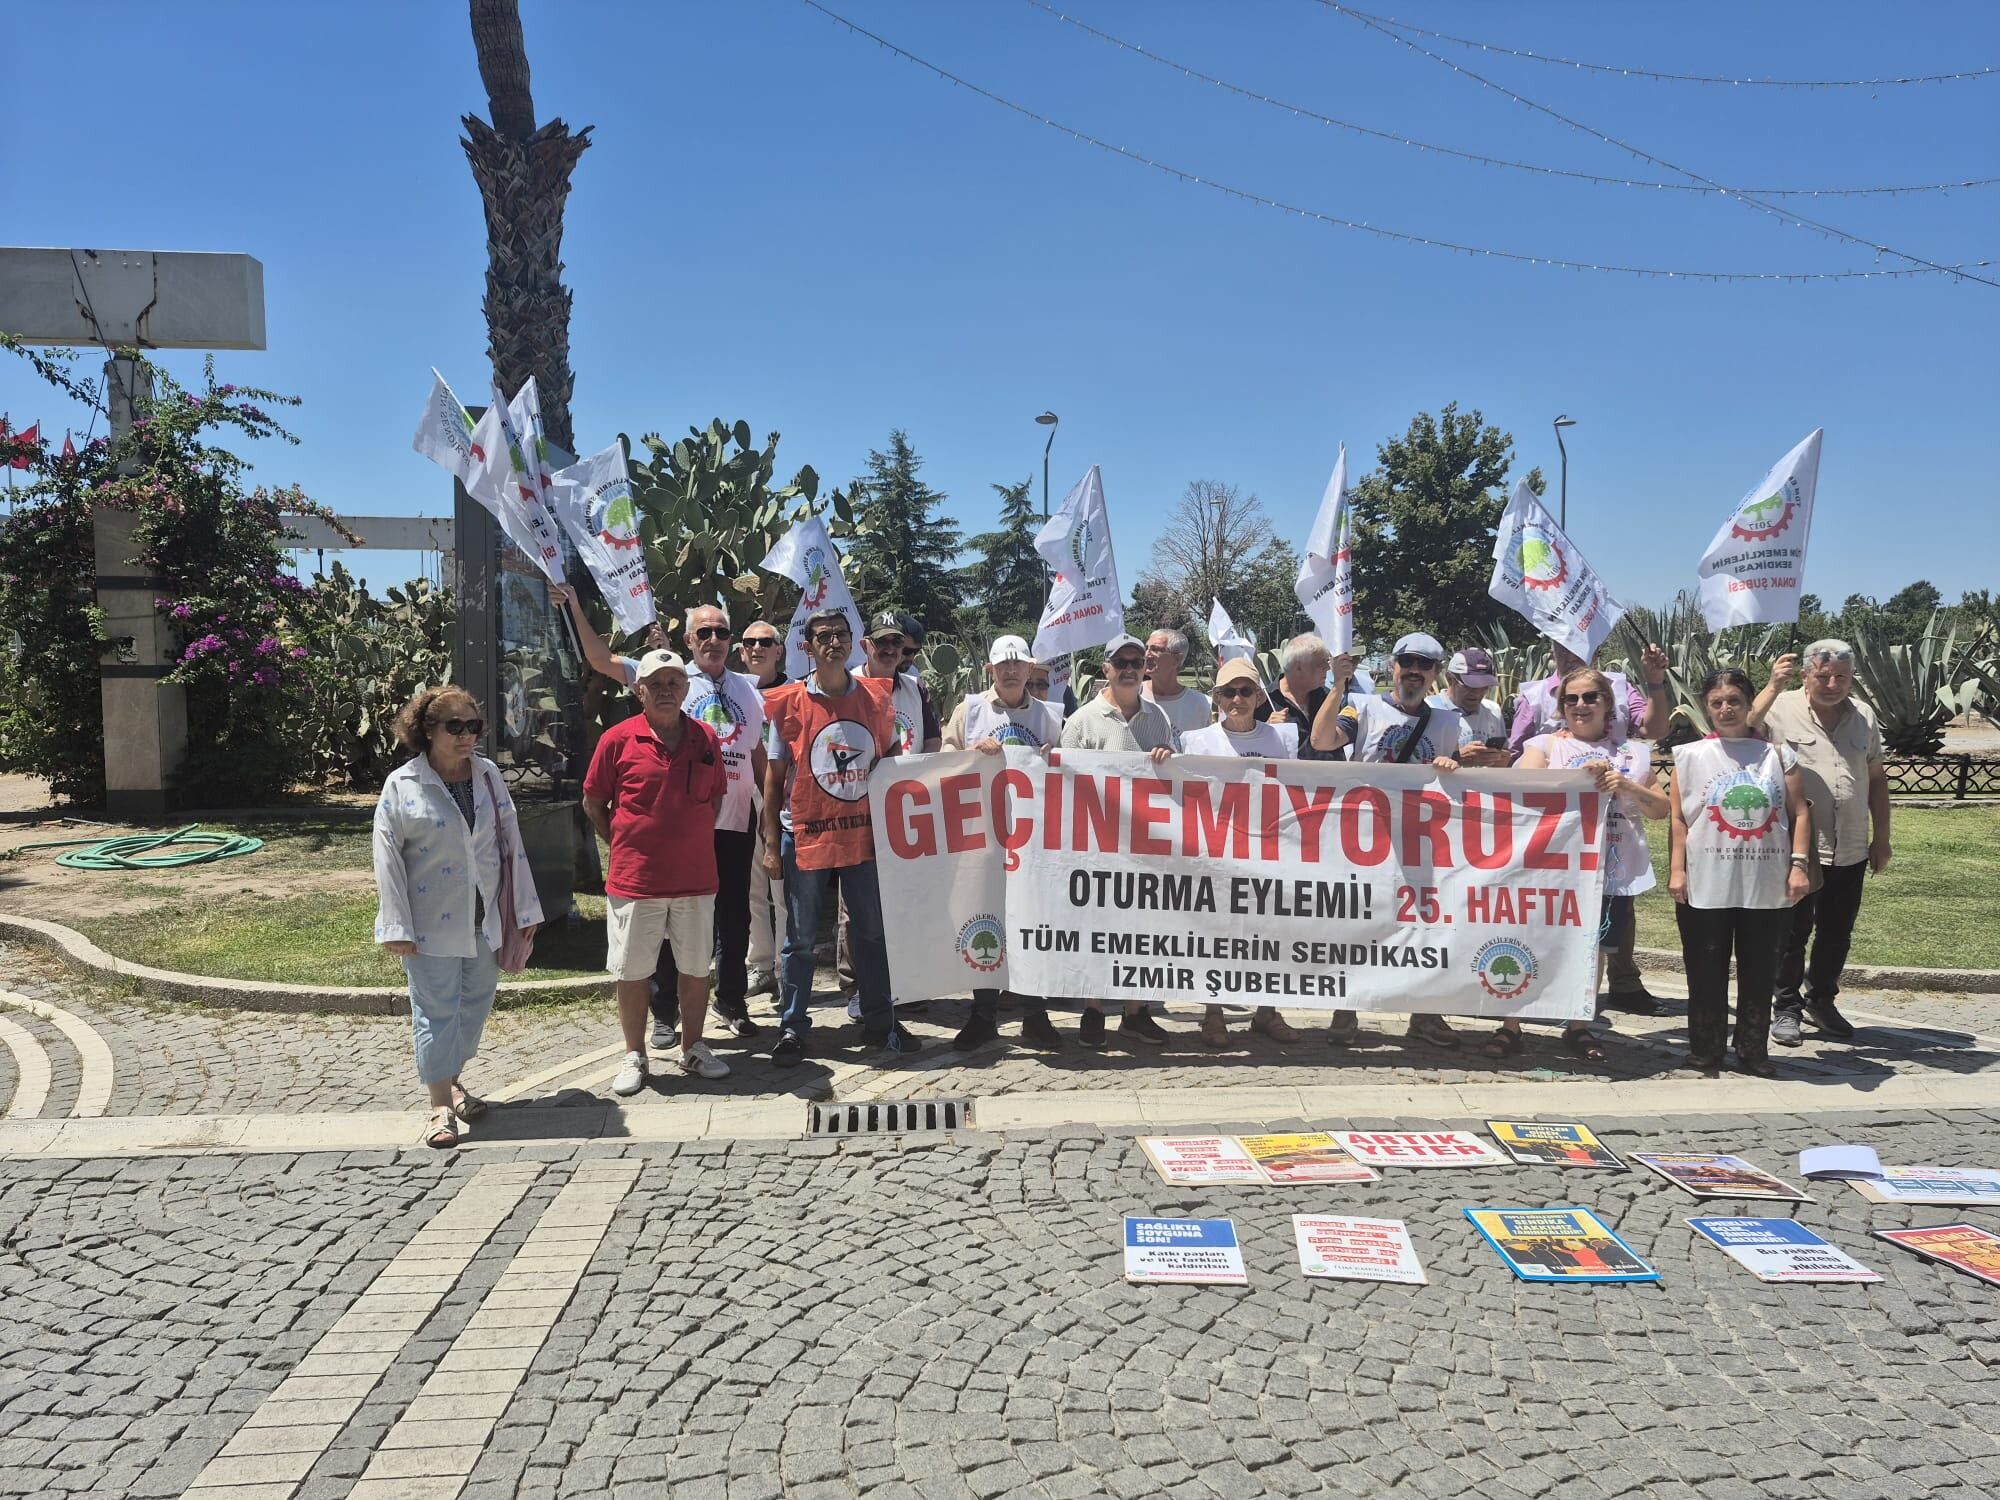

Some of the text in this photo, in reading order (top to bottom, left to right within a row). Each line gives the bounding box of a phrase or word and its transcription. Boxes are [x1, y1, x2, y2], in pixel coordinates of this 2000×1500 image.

[988, 722, 1025, 737] MEKLİLERİN
[884, 753, 1599, 871] GEÇİNEMİYORUZ!
[1069, 870, 1582, 927] OTURMA EYLEMİ! 25. HAFTA
[1019, 924, 1080, 952] TÜM
[1092, 929, 1280, 962] EMEKLİLERİN
[1291, 937, 1449, 969] SENDİKASI
[1112, 960, 1346, 997] İZMİR ŞUBELERİ
[1348, 1134, 1465, 1144] ARTIK
[1353, 1145, 1486, 1155] YETER
[1136, 1230, 1203, 1238] SOYGUNA
